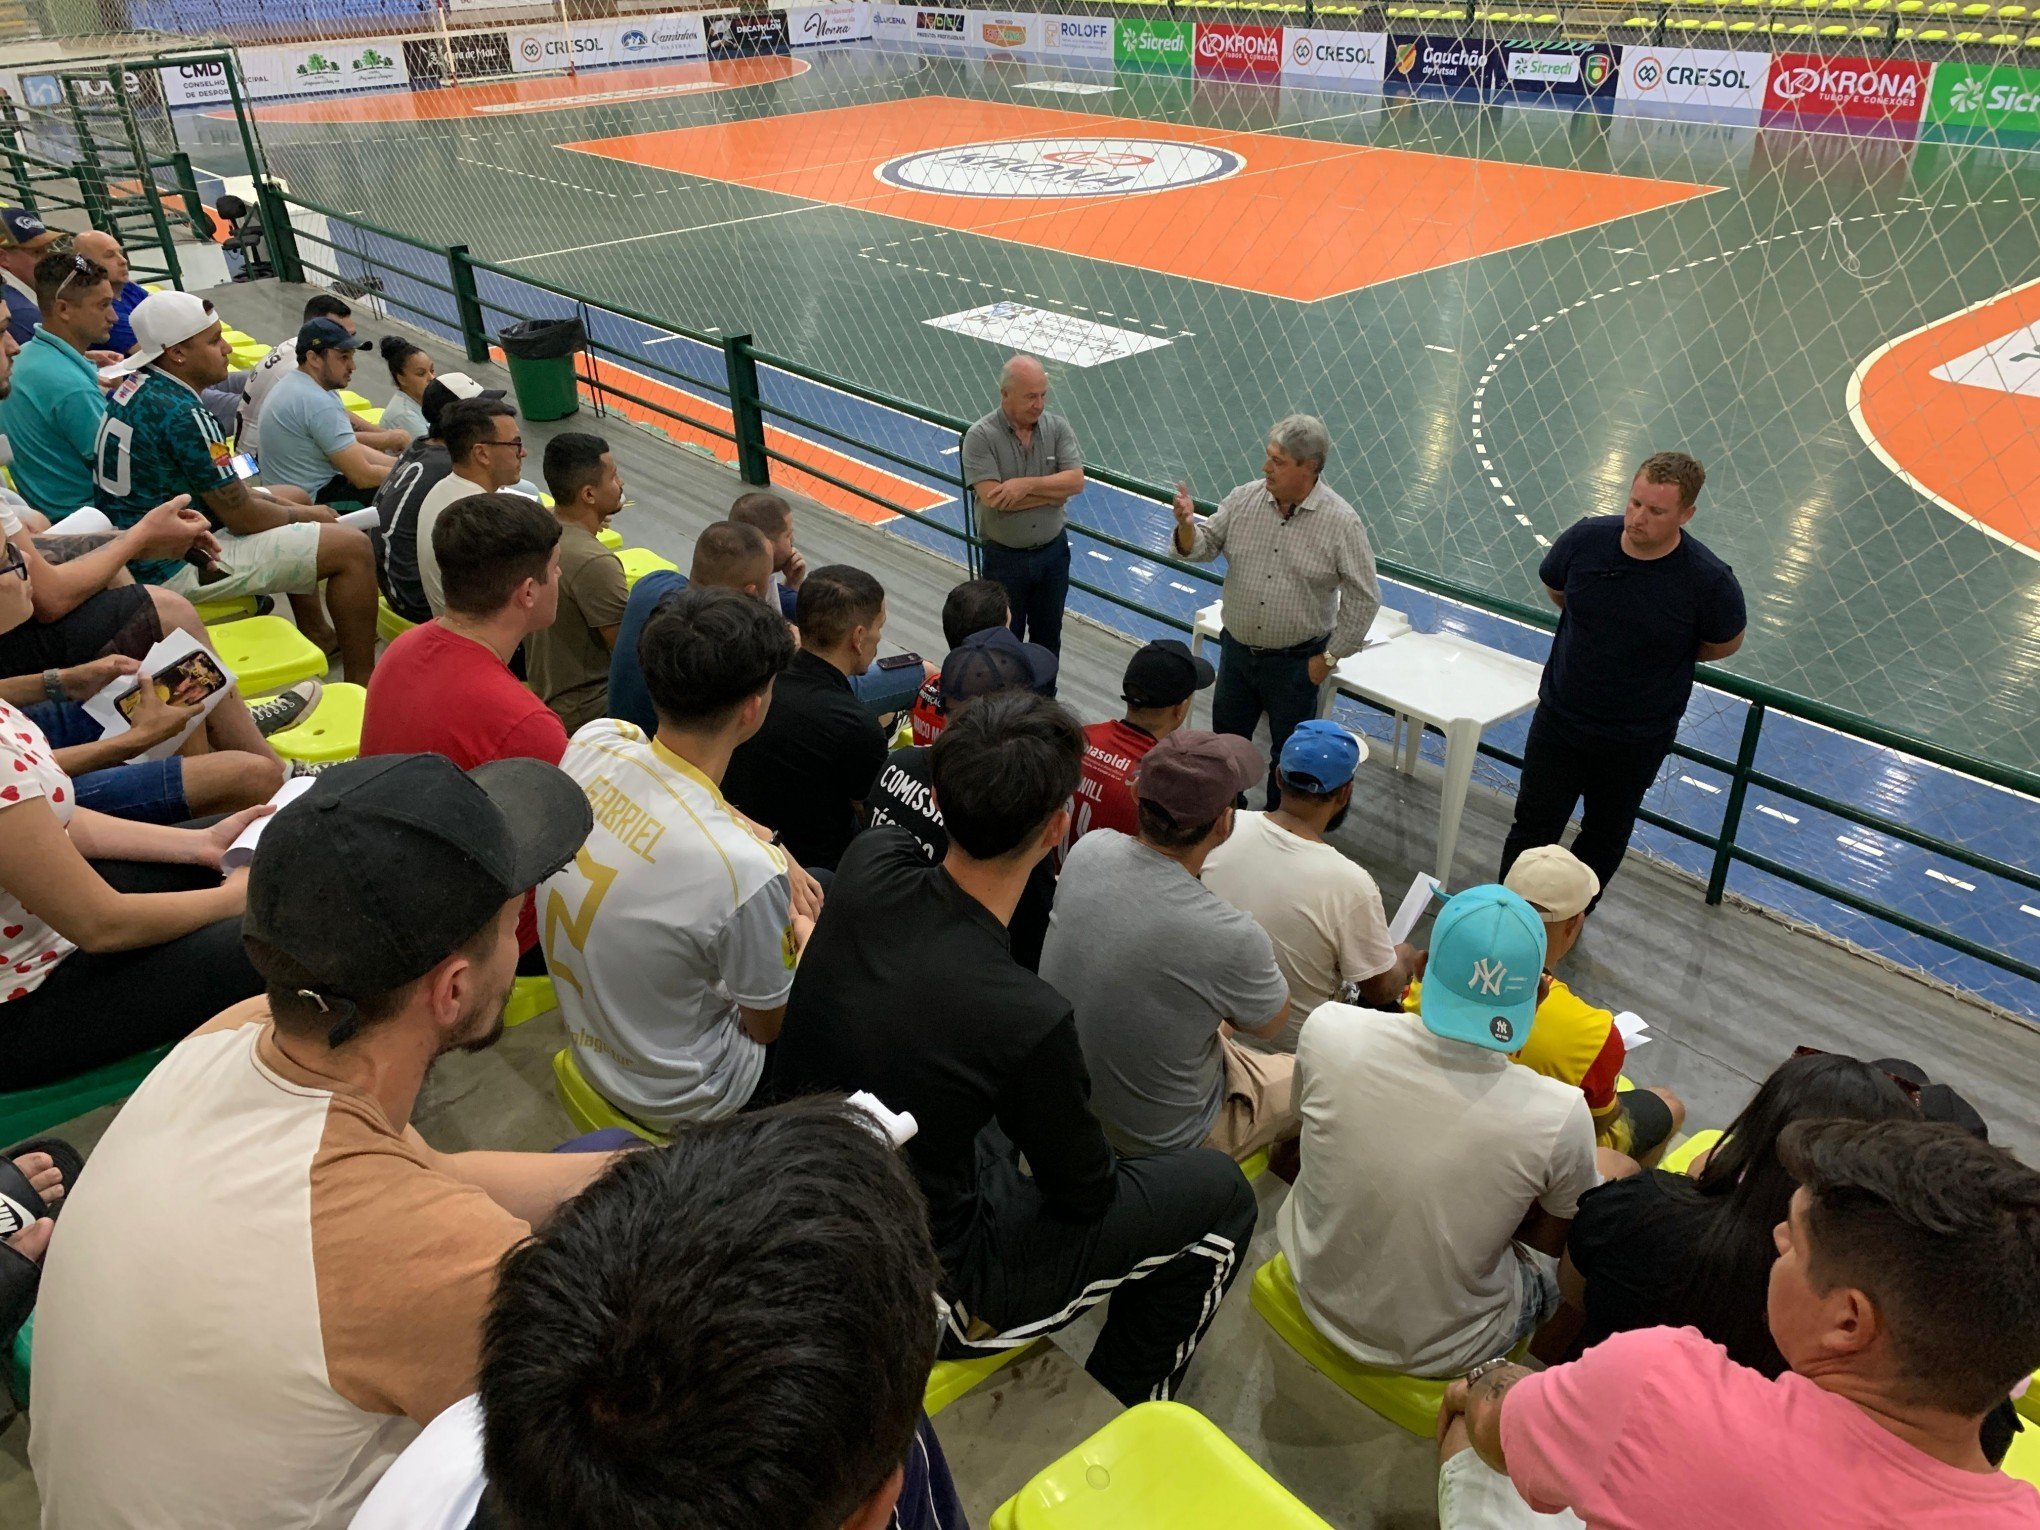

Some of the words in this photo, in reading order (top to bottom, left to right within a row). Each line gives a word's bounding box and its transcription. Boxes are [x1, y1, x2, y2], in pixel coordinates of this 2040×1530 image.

[651, 29, 698, 46] Caminhos
[736, 22, 782, 34] DECATHLON
[1061, 22, 1107, 38] ROLOFF
[1138, 33, 1185, 52] Sicredi
[1225, 35, 1278, 56] KRONA
[1316, 45, 1375, 65] CRESOL
[1423, 47, 1488, 67] Gauchão
[180, 61, 222, 79] CMD
[1431, 66, 1457, 77] futsal
[1530, 60, 1573, 75] Sicredi
[183, 79, 226, 89] CONSELHO
[1666, 66, 1750, 89] CRESOL
[1820, 70, 1917, 99] KRONA
[584, 774, 667, 865] GABRIEL
[1468, 957, 1507, 997] NY
